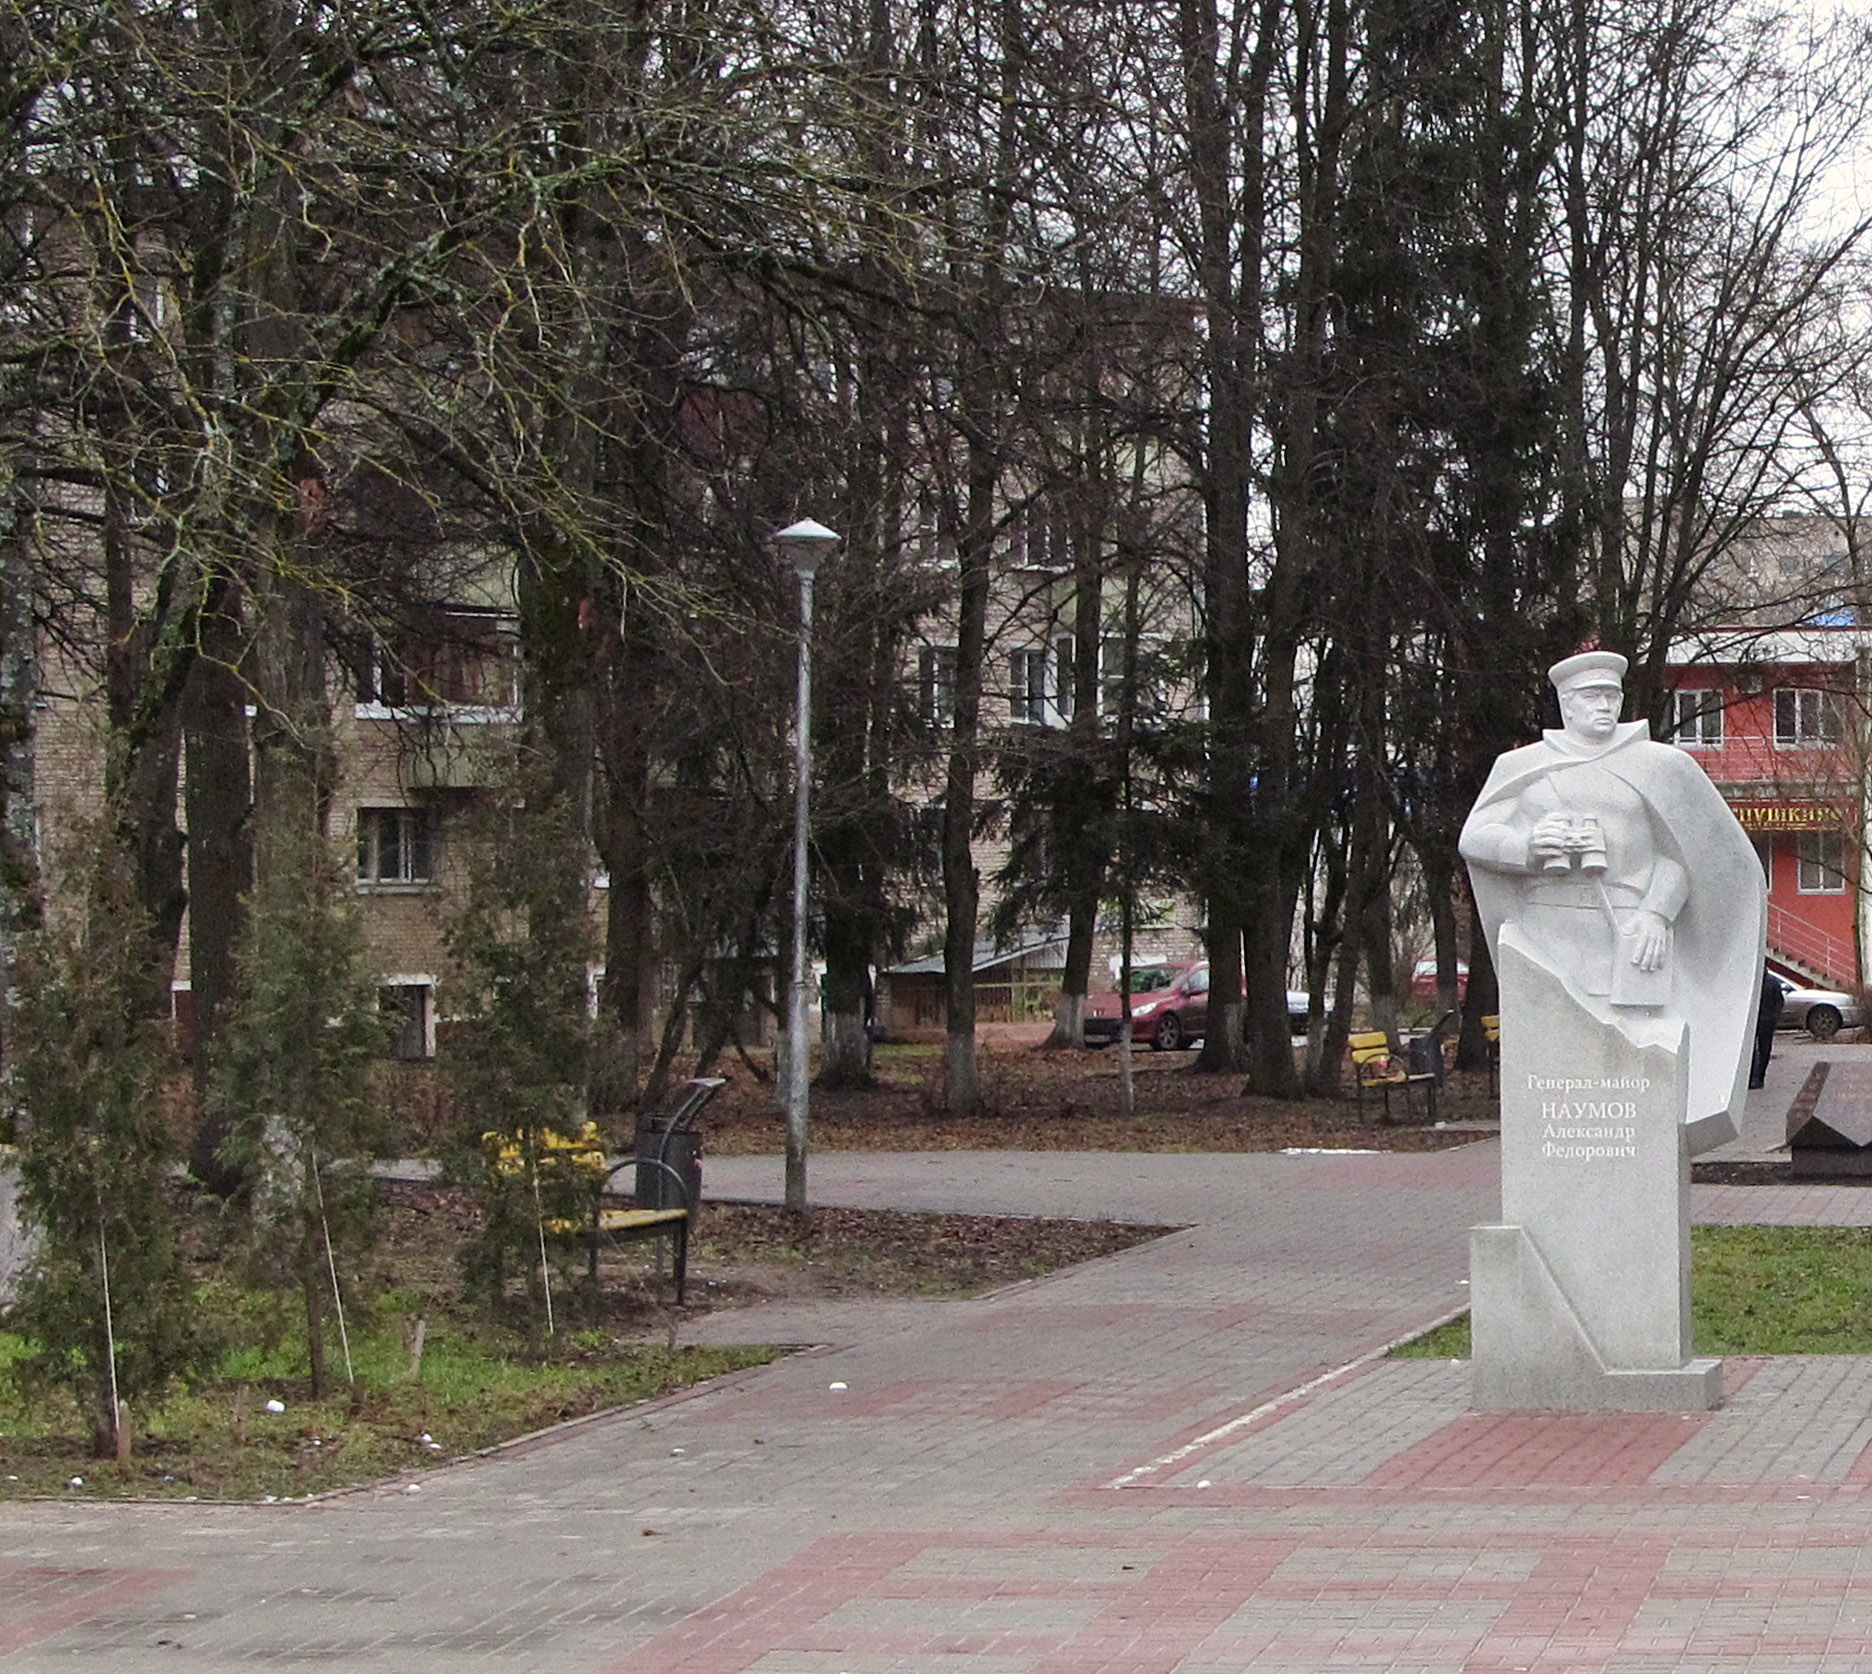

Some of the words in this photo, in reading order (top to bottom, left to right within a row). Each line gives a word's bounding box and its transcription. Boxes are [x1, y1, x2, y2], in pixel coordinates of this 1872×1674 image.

[1527, 1075, 1650, 1093] Генерал-майор
[1541, 1102, 1637, 1119] НАУМОВ
[1542, 1123, 1636, 1143] Александр
[1541, 1141, 1636, 1161] Федорович
